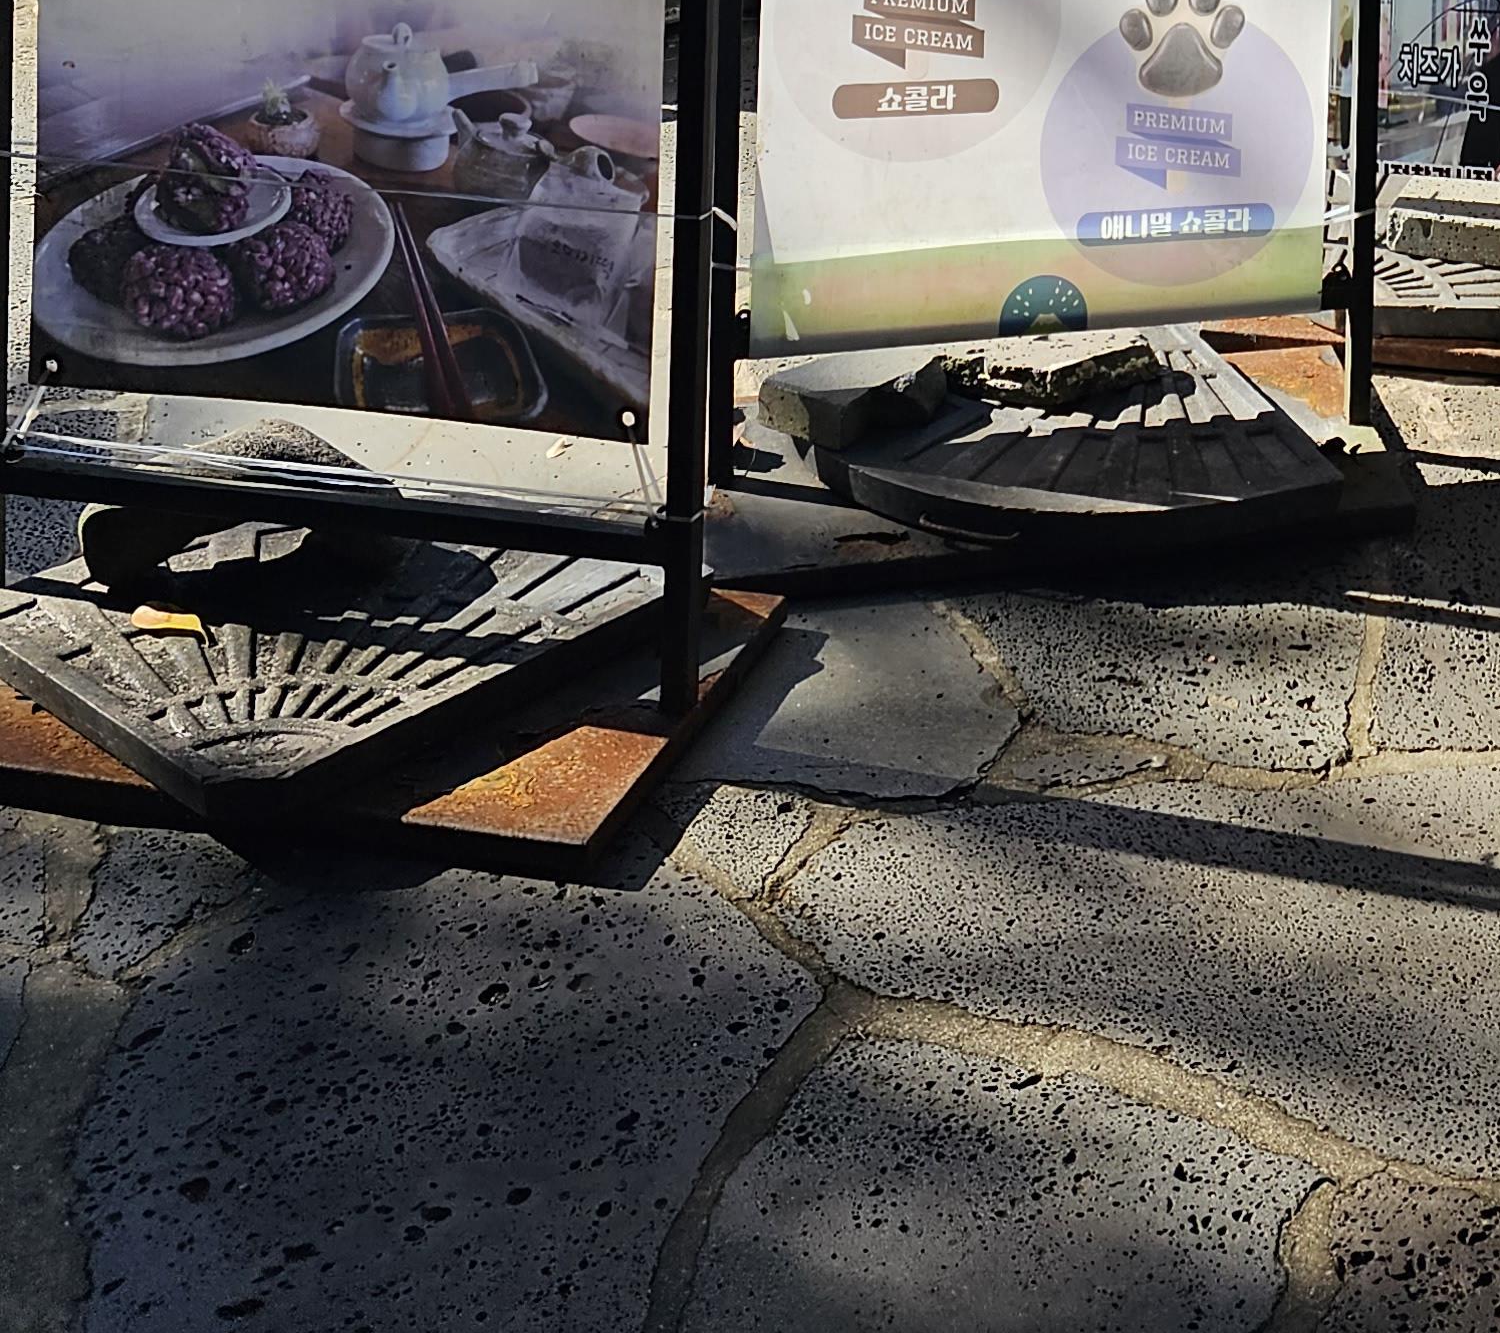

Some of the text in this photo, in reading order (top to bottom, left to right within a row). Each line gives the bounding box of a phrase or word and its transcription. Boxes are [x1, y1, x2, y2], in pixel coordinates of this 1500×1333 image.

[864, 24, 974, 51] ICE CREAM
[1399, 44, 1460, 88] 치즈가
[876, 86, 957, 112] 쇼콜라
[1133, 110, 1226, 135] PREMIUM
[1127, 143, 1231, 169] ICE CREAM
[1101, 207, 1251, 240] 애니멀 쇼콜라
